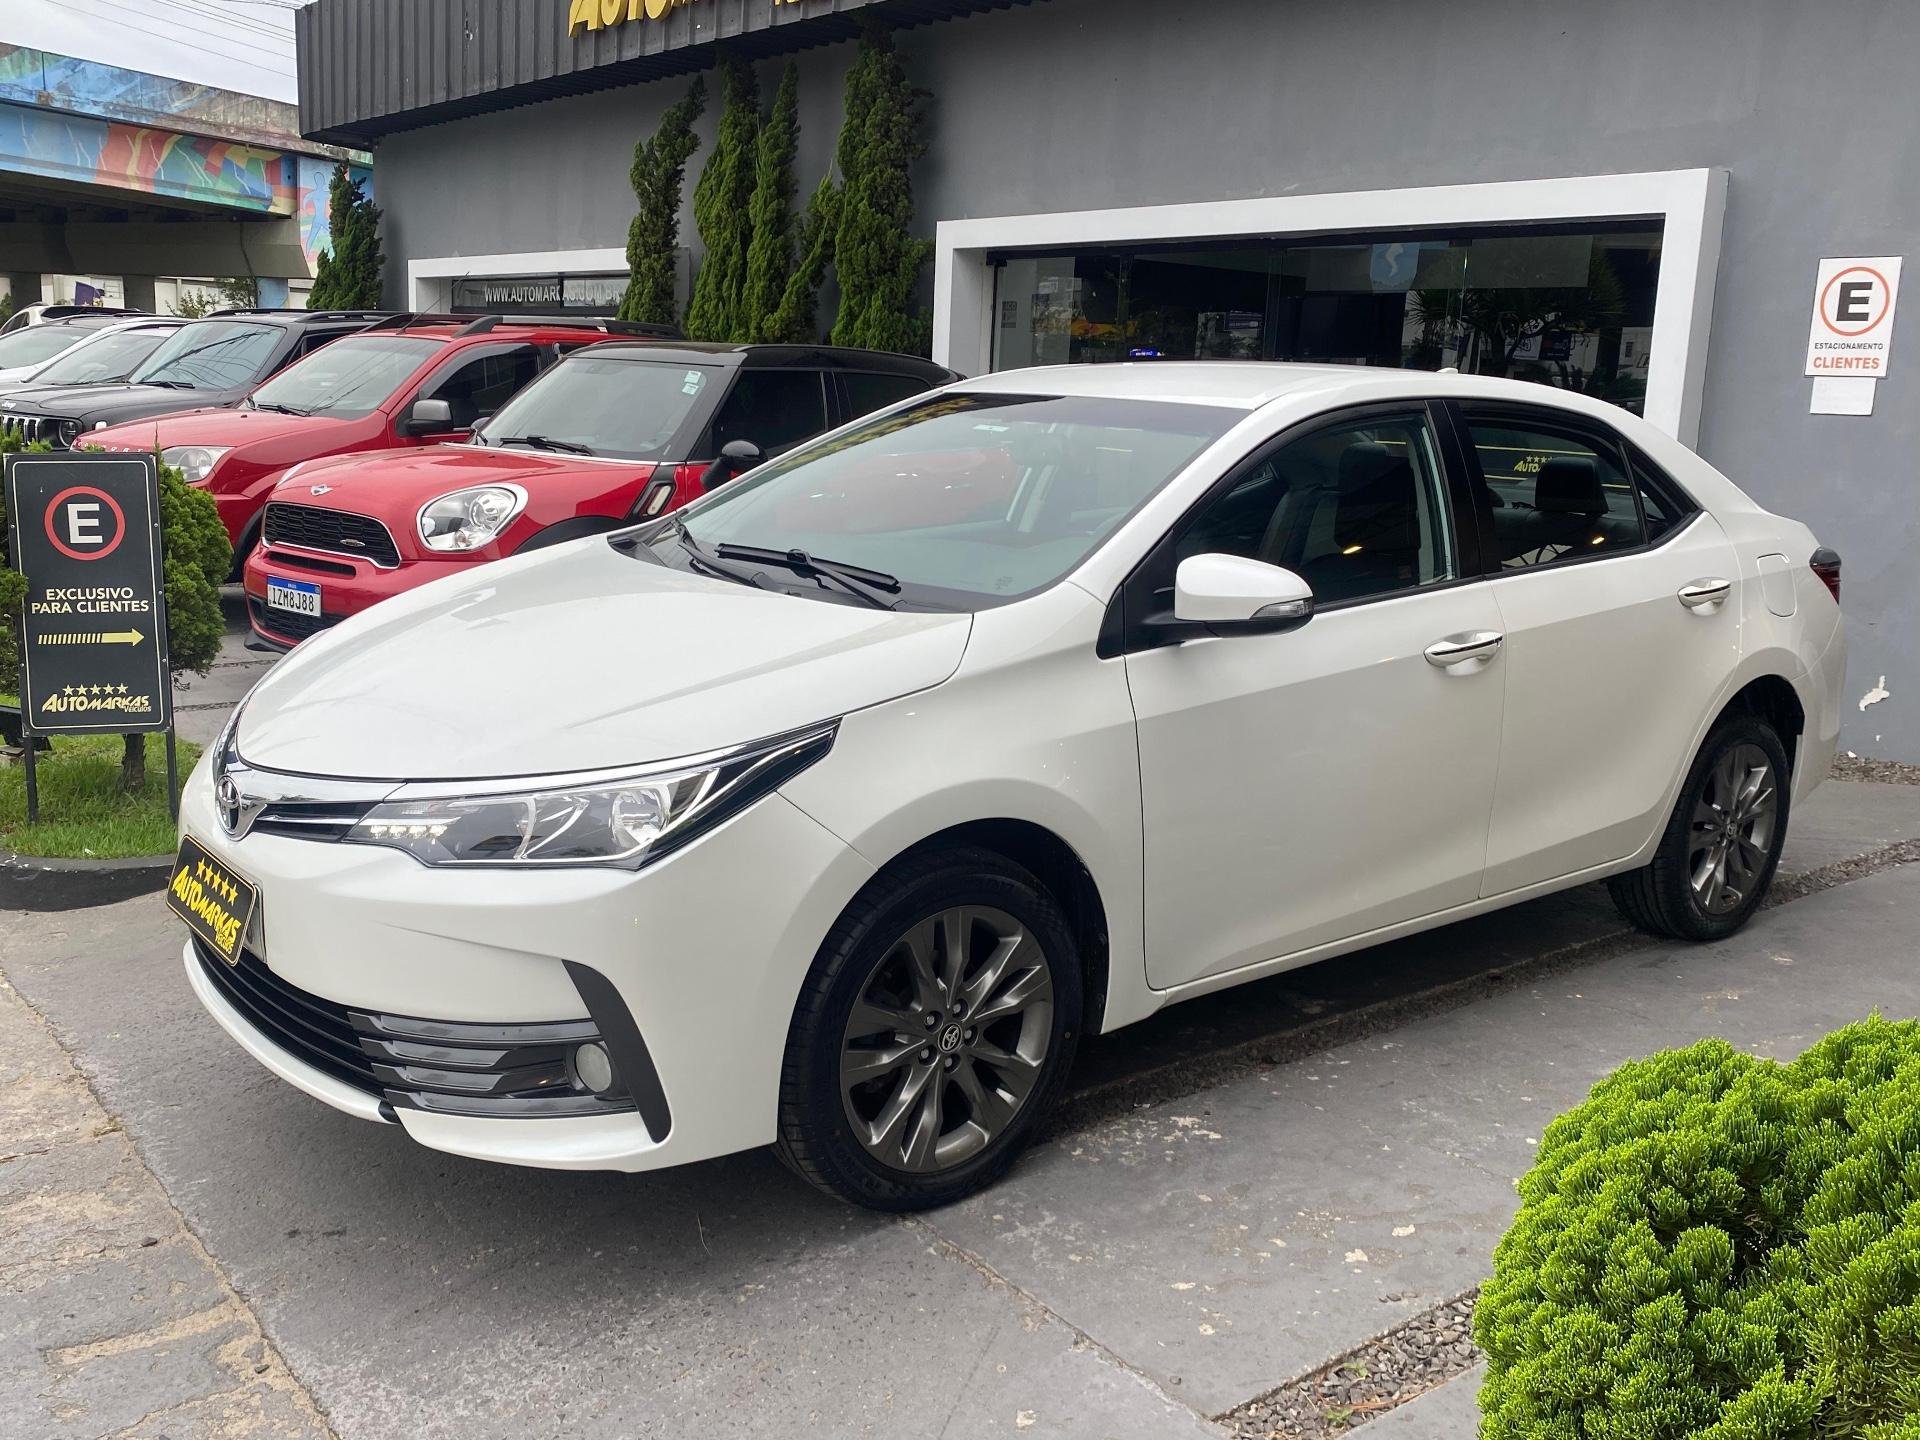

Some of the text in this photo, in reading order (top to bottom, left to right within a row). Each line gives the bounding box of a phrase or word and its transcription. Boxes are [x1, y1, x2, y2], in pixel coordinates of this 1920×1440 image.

[1836, 282, 1873, 321] E
[1814, 342, 1884, 350] ESTACIONAMENTO
[1813, 357, 1880, 369] CLIENTES
[1514, 460, 1541, 472] AUTO
[67, 503, 103, 544] E
[46, 587, 134, 601] EXCLUSIVO
[272, 588, 314, 612] IZM8J88
[31, 600, 149, 615] PARA CLIENTES
[41, 693, 149, 713] AUTOMARKAS
[171, 865, 242, 942] AUTOMARKAS
